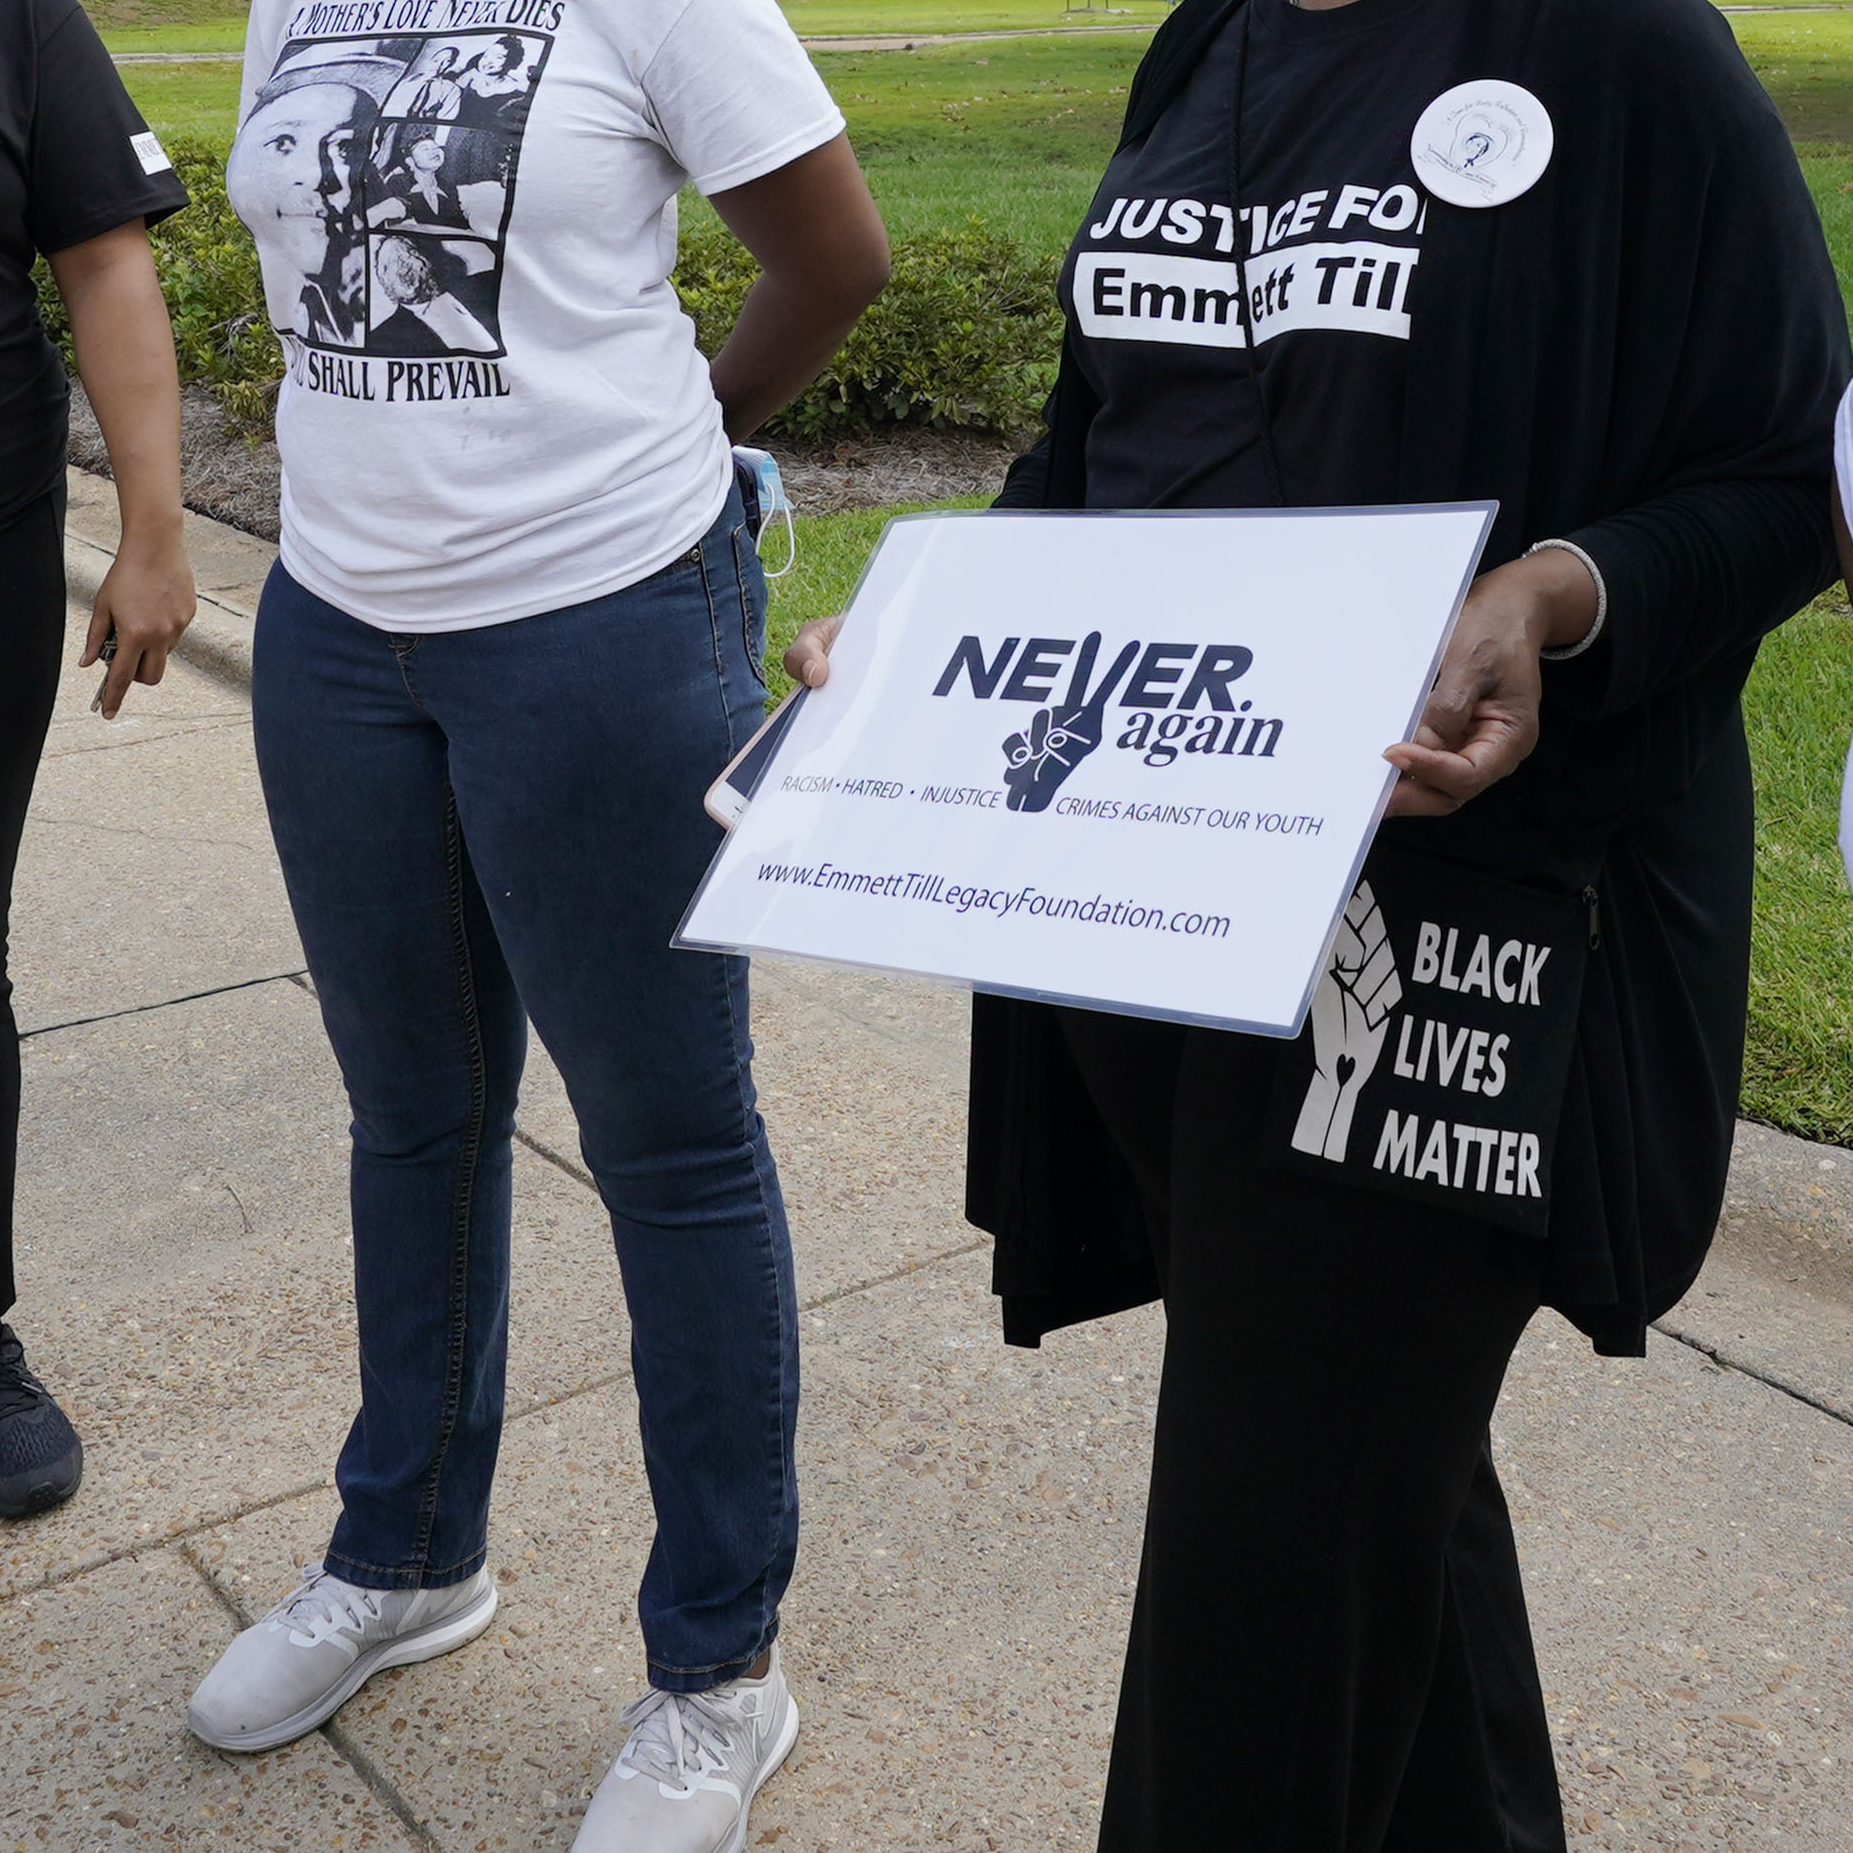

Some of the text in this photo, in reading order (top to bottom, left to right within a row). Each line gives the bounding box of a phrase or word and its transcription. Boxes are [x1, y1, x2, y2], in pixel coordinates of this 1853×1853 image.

[1089, 184, 1428, 254] JUSTICE FO
[1093, 262, 1296, 326] Emmett
[308, 350, 376, 402] SHALL
[385, 360, 512, 403] PREVAIL
[932, 630, 1255, 713] NEVER
[1115, 699, 1285, 768] again
[779, 774, 1325, 837] RACISM HATRED INJUSTICE CRIMES AGAINST OUR YOUTH
[757, 862, 1231, 939] www.EmmettTillLegacyFoundation.com
[1411, 920, 1552, 1007] BLACK
[1393, 1013, 1511, 1098] LIVES
[1372, 1109, 1543, 1198] MATTER
